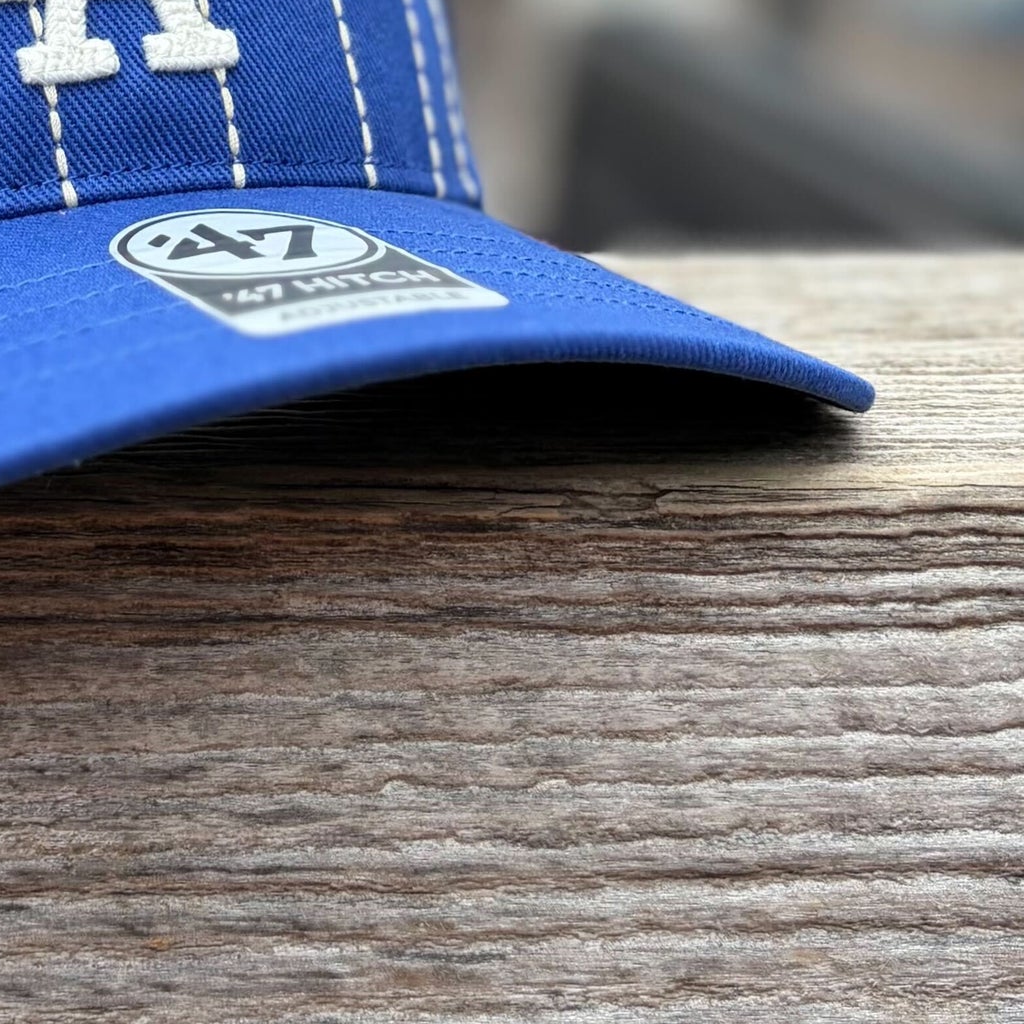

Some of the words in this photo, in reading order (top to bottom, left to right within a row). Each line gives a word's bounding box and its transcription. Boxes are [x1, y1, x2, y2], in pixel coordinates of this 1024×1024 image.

[147, 223, 319, 261] '47
[222, 284, 283, 304] '47
[292, 270, 440, 293] HITCH
[280, 290, 467, 321] ADJUSTABLE
